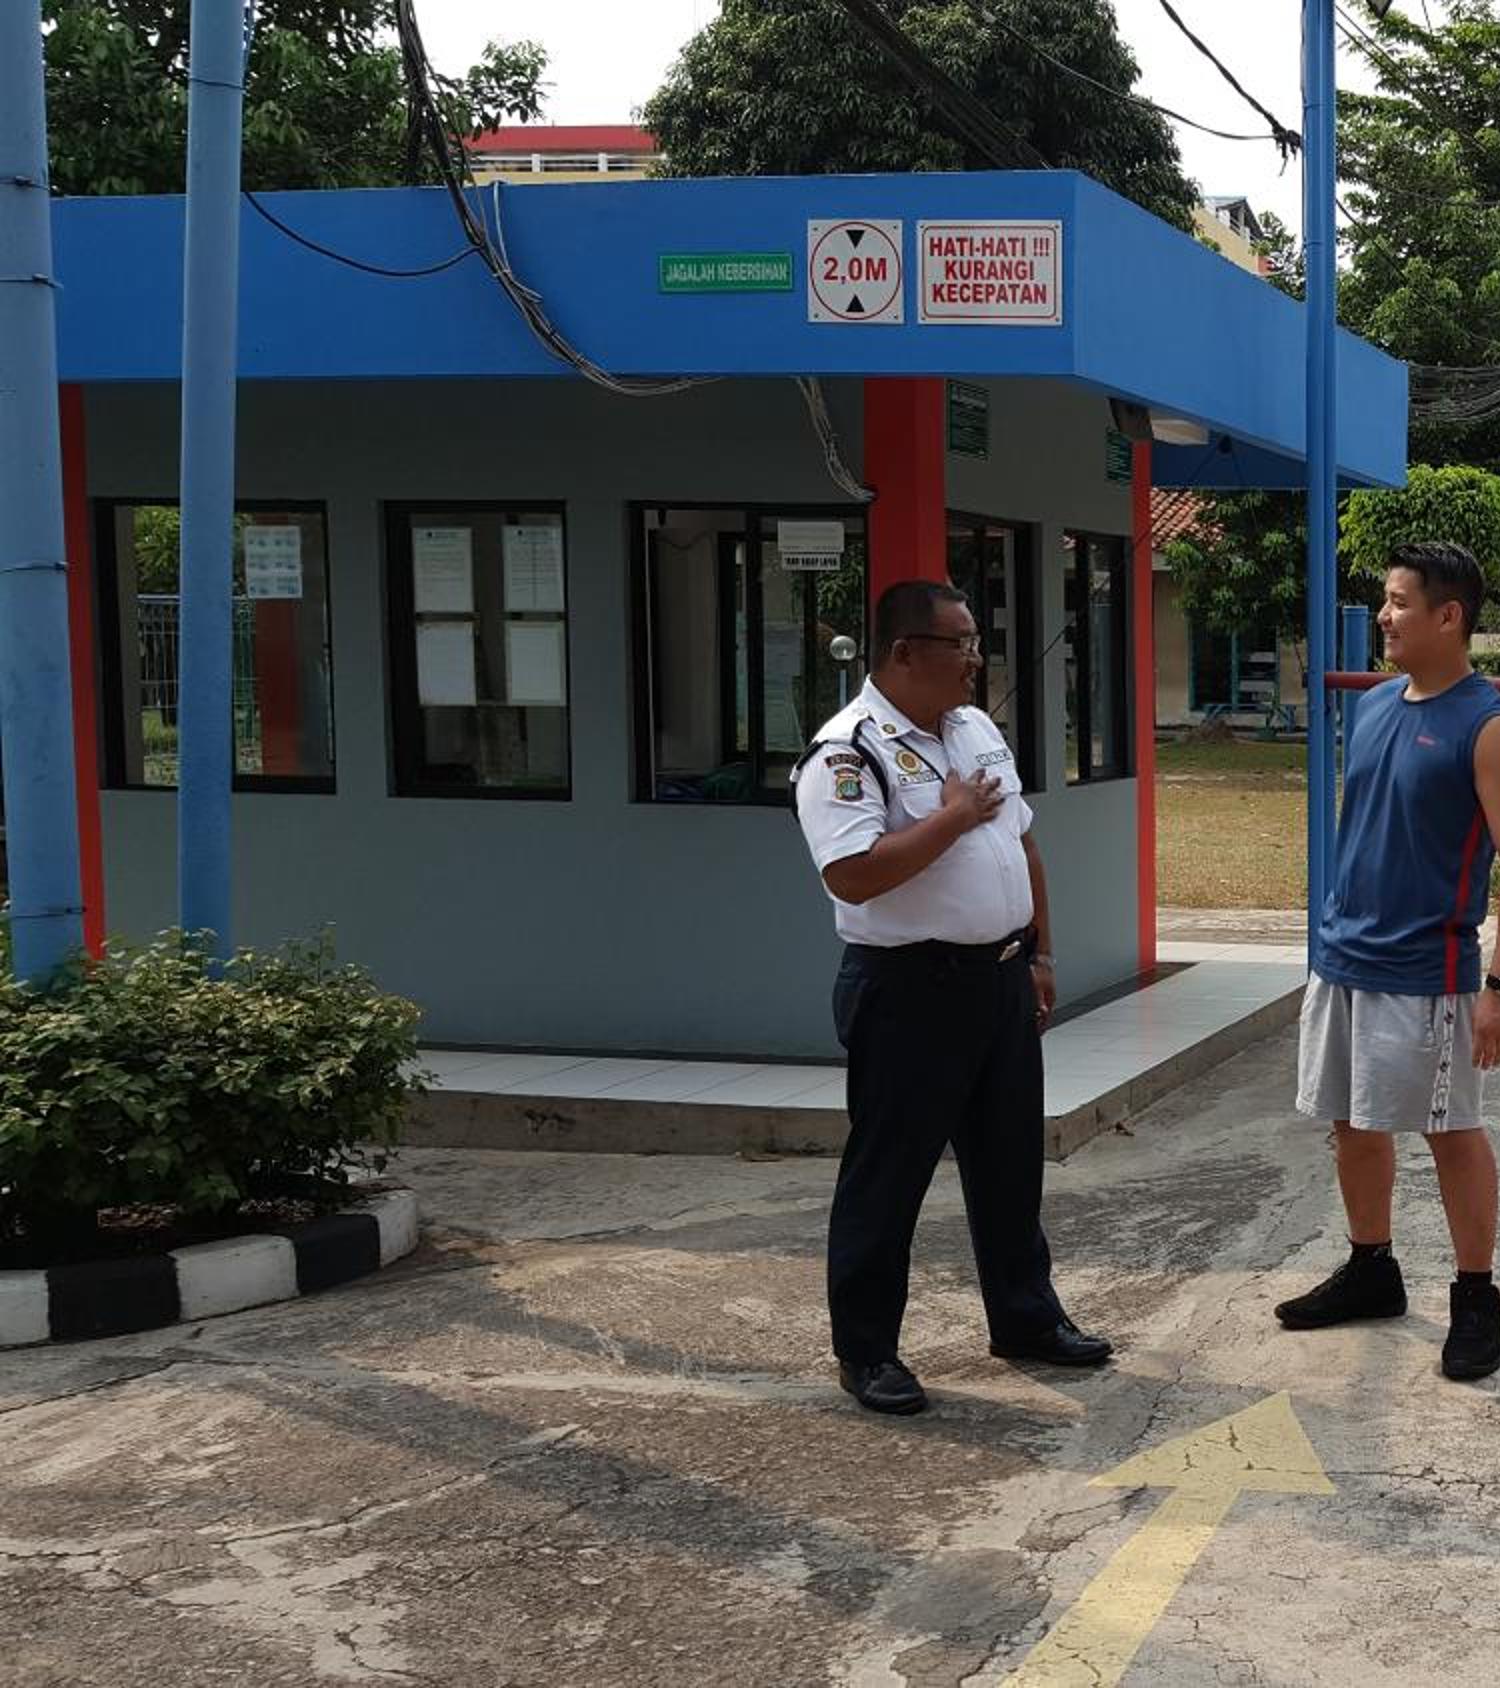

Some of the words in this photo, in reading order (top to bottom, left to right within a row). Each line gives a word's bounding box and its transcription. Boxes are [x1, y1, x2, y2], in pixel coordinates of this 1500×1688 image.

[929, 237, 1025, 257] HATI-HATI
[1033, 237, 1050, 257] !!!
[665, 263, 715, 283] JAGALAH
[717, 262, 787, 281] KEBERSIHAN
[823, 257, 887, 284] 2,0M
[932, 283, 1047, 304] KECEPATAN
